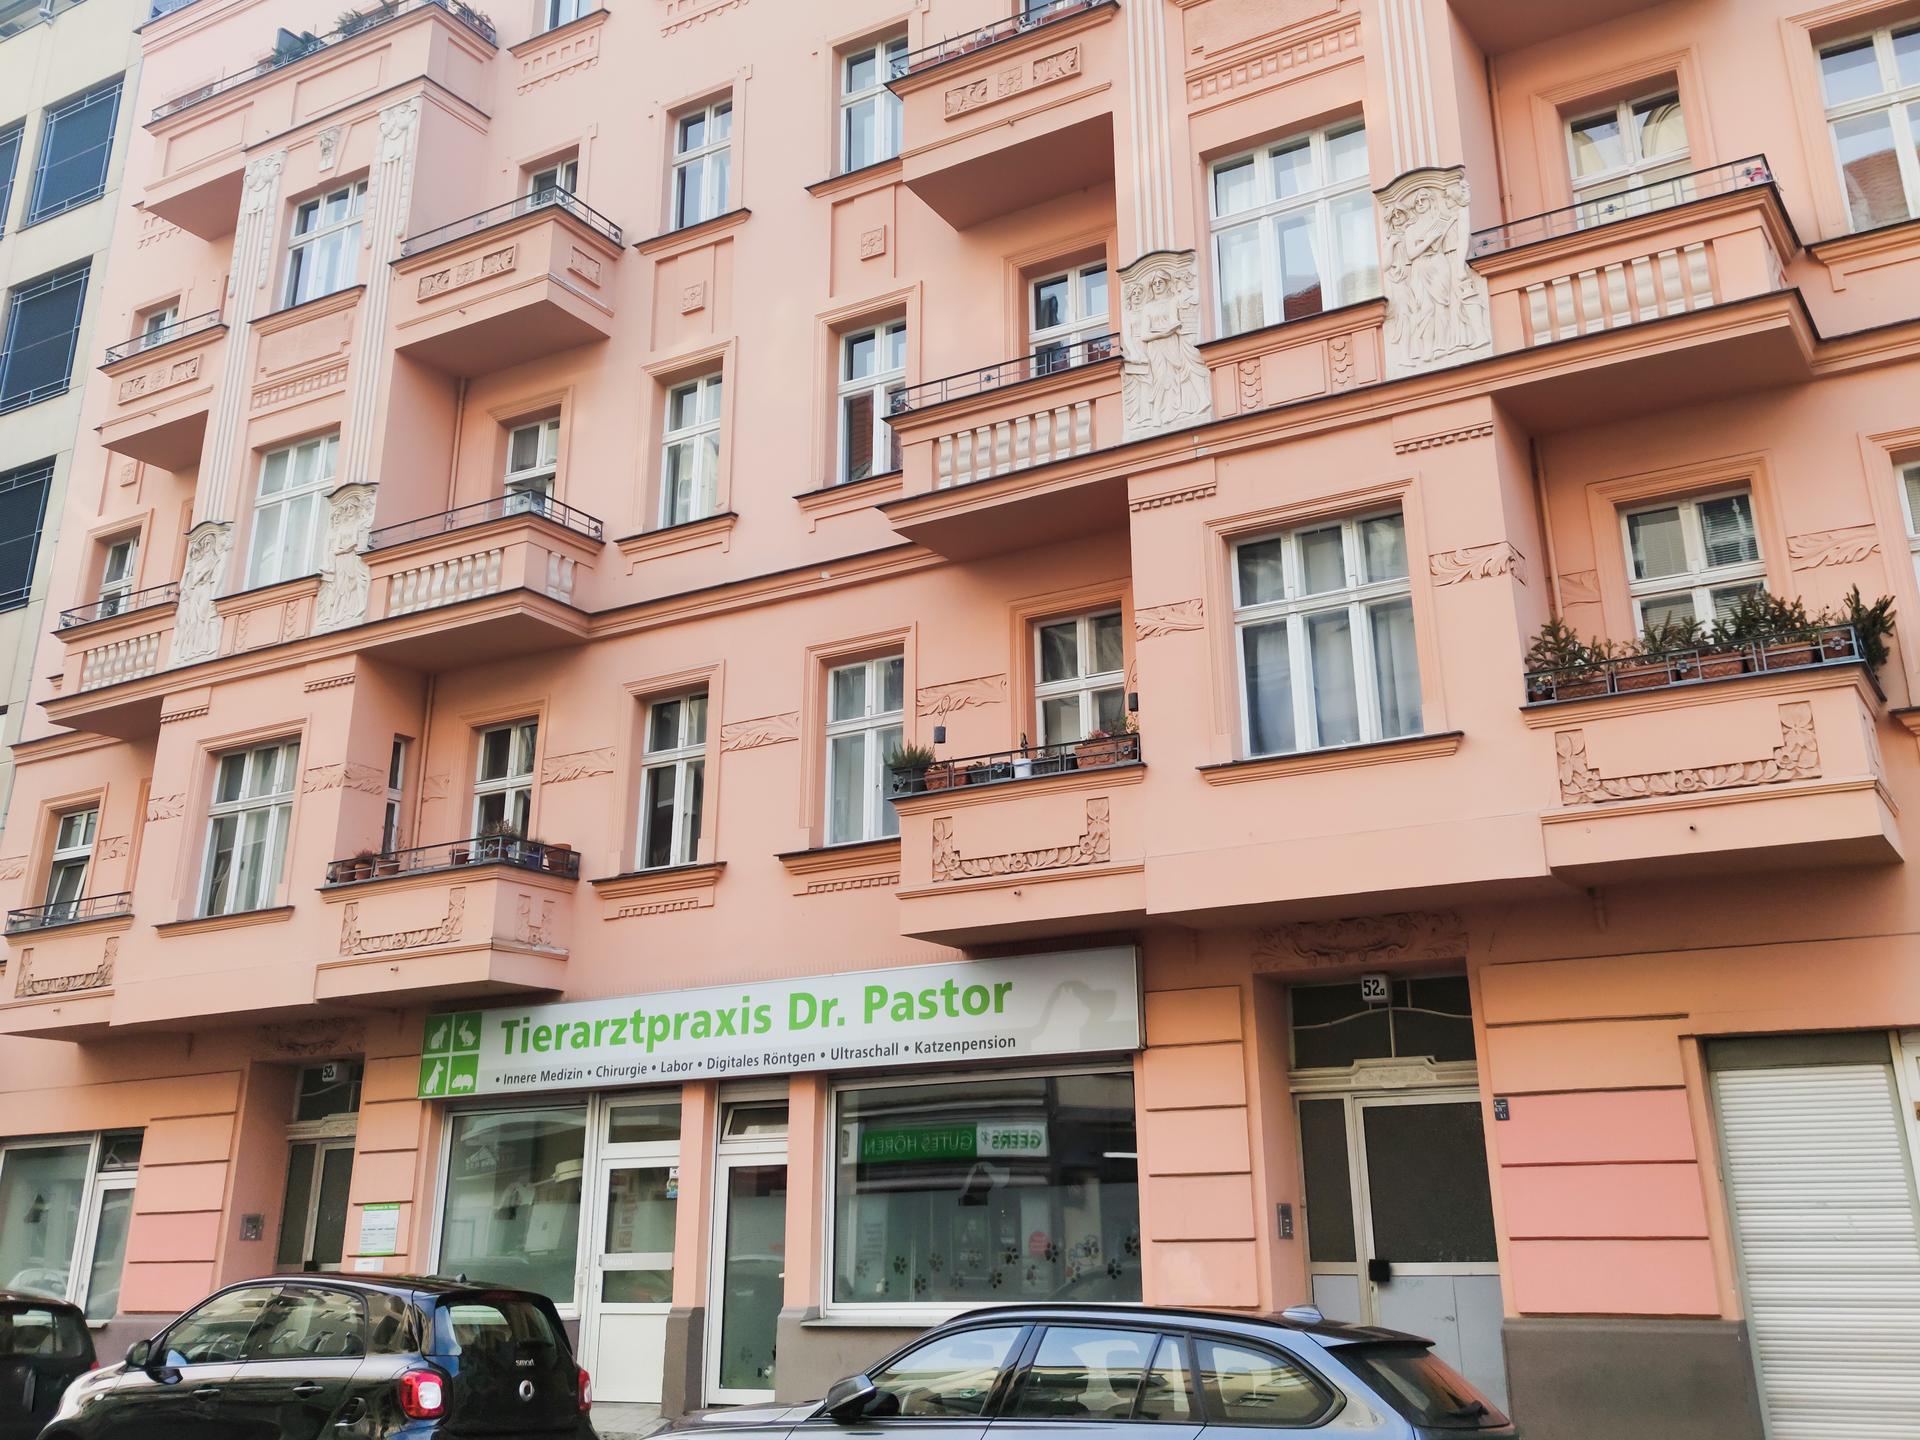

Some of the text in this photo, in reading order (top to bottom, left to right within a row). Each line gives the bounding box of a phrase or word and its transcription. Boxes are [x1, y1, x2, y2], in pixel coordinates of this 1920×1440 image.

[1363, 979, 1385, 996] 52a
[501, 978, 1013, 1054] Tierarztpraxis Dr. Pastor
[503, 1036, 1016, 1086] Innere Medizin Chirurgie Labor Digitales Röntgen Ultraschall Katzenpension
